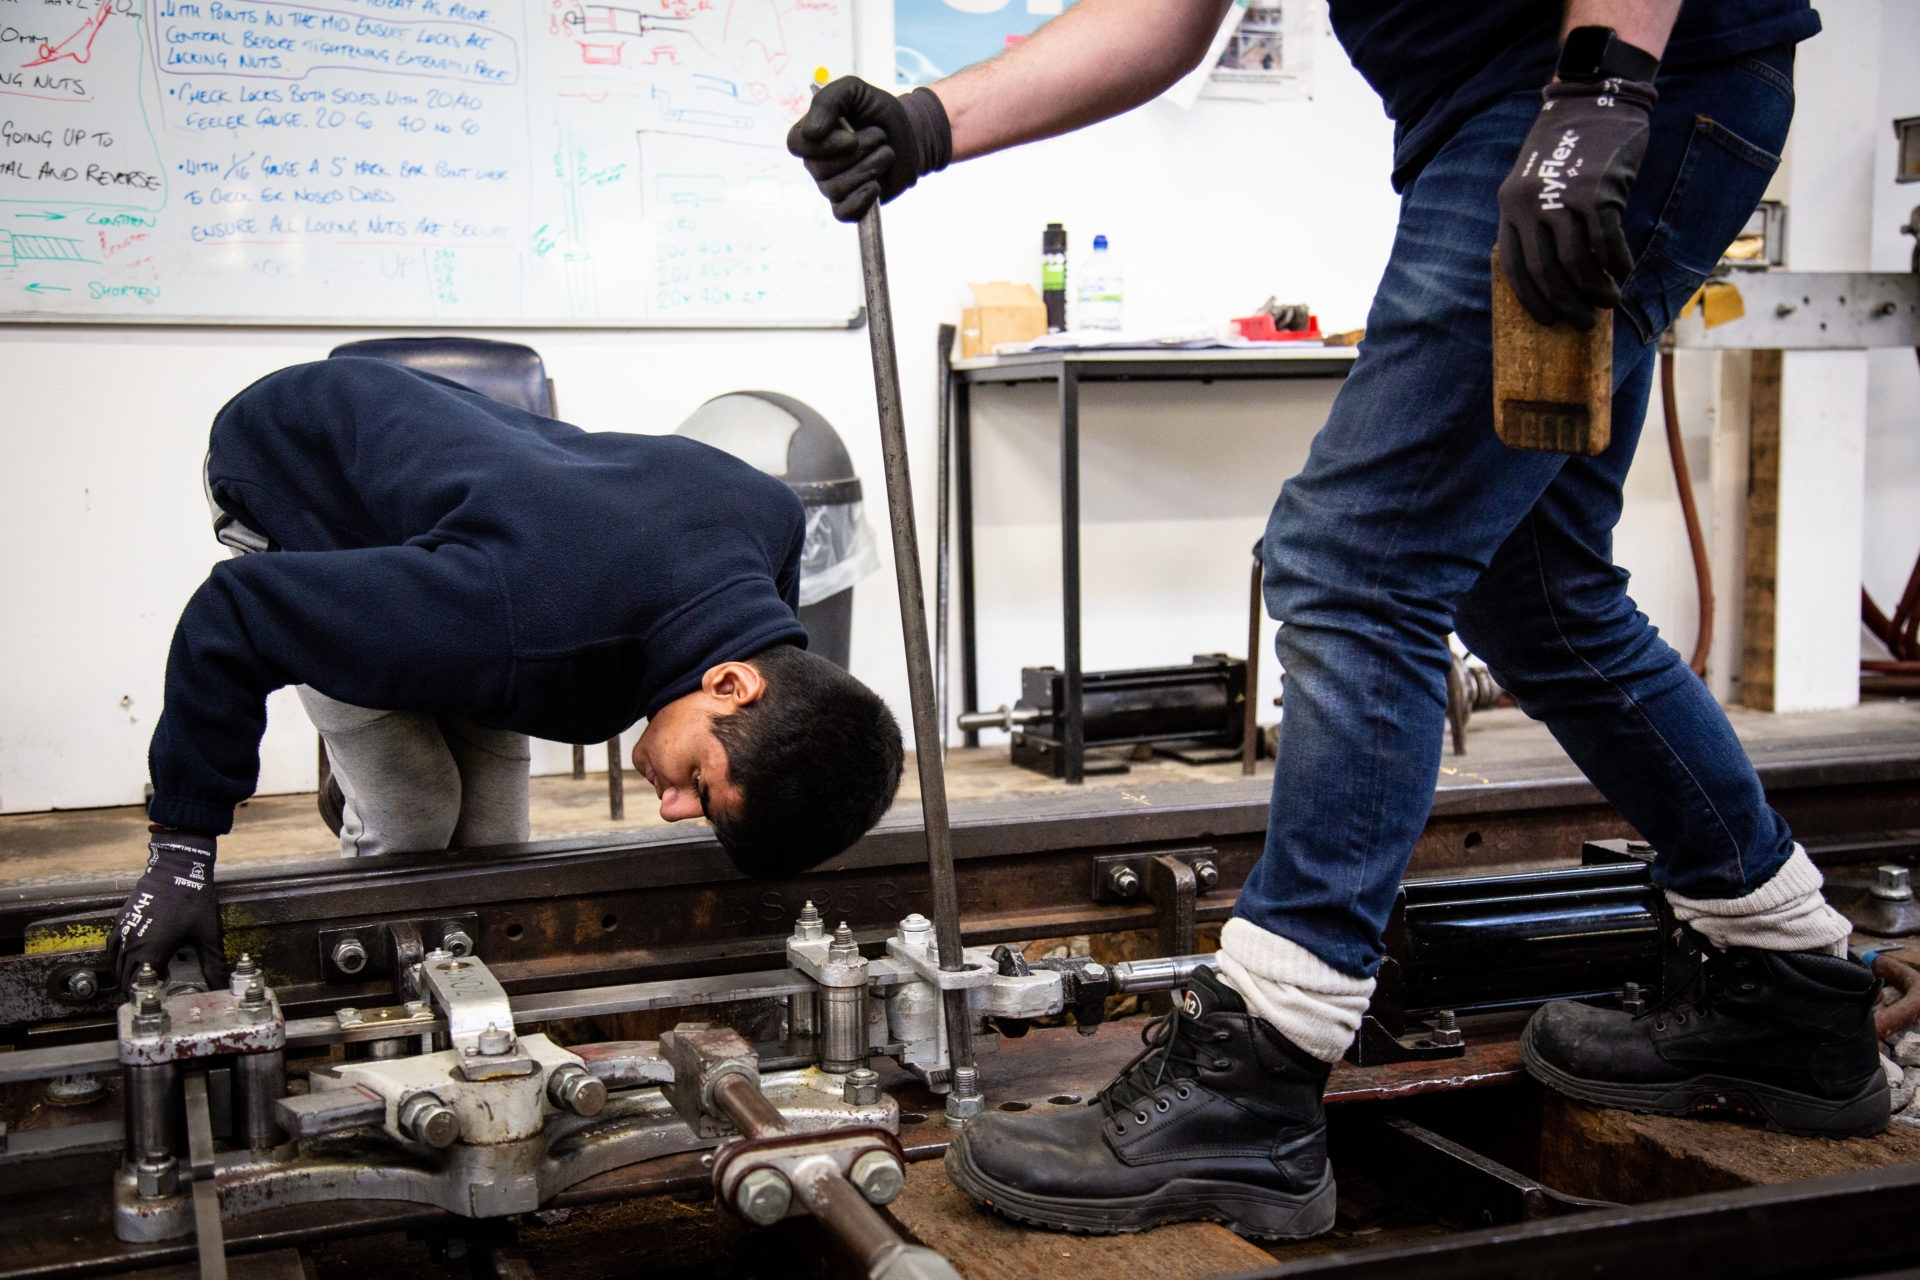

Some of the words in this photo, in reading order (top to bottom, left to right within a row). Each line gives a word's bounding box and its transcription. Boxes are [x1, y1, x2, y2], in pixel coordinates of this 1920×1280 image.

[210, 2, 258, 23] POINTS
[265, 10, 283, 27] IN
[288, 12, 318, 29] THE
[166, 25, 233, 44] CENTRAL
[243, 31, 297, 51] BEFORE
[167, 47, 227, 68] LOCKING
[179, 82, 232, 105] CHECK
[240, 86, 283, 103] LOCKS
[289, 84, 325, 104] BOTH
[331, 88, 380, 106] SIDES
[2, 121, 52, 148] GOING
[64, 128, 86, 146] UP
[186, 112, 249, 130] FEELER
[398, 115, 426, 133] 40
[38, 161, 78, 182] AND
[86, 164, 161, 191] REVERSE
[191, 219, 257, 242] ENSURE
[269, 215, 298, 234] ALL
[367, 214, 408, 236] NUTS
[173, 876, 206, 890] Ansell
